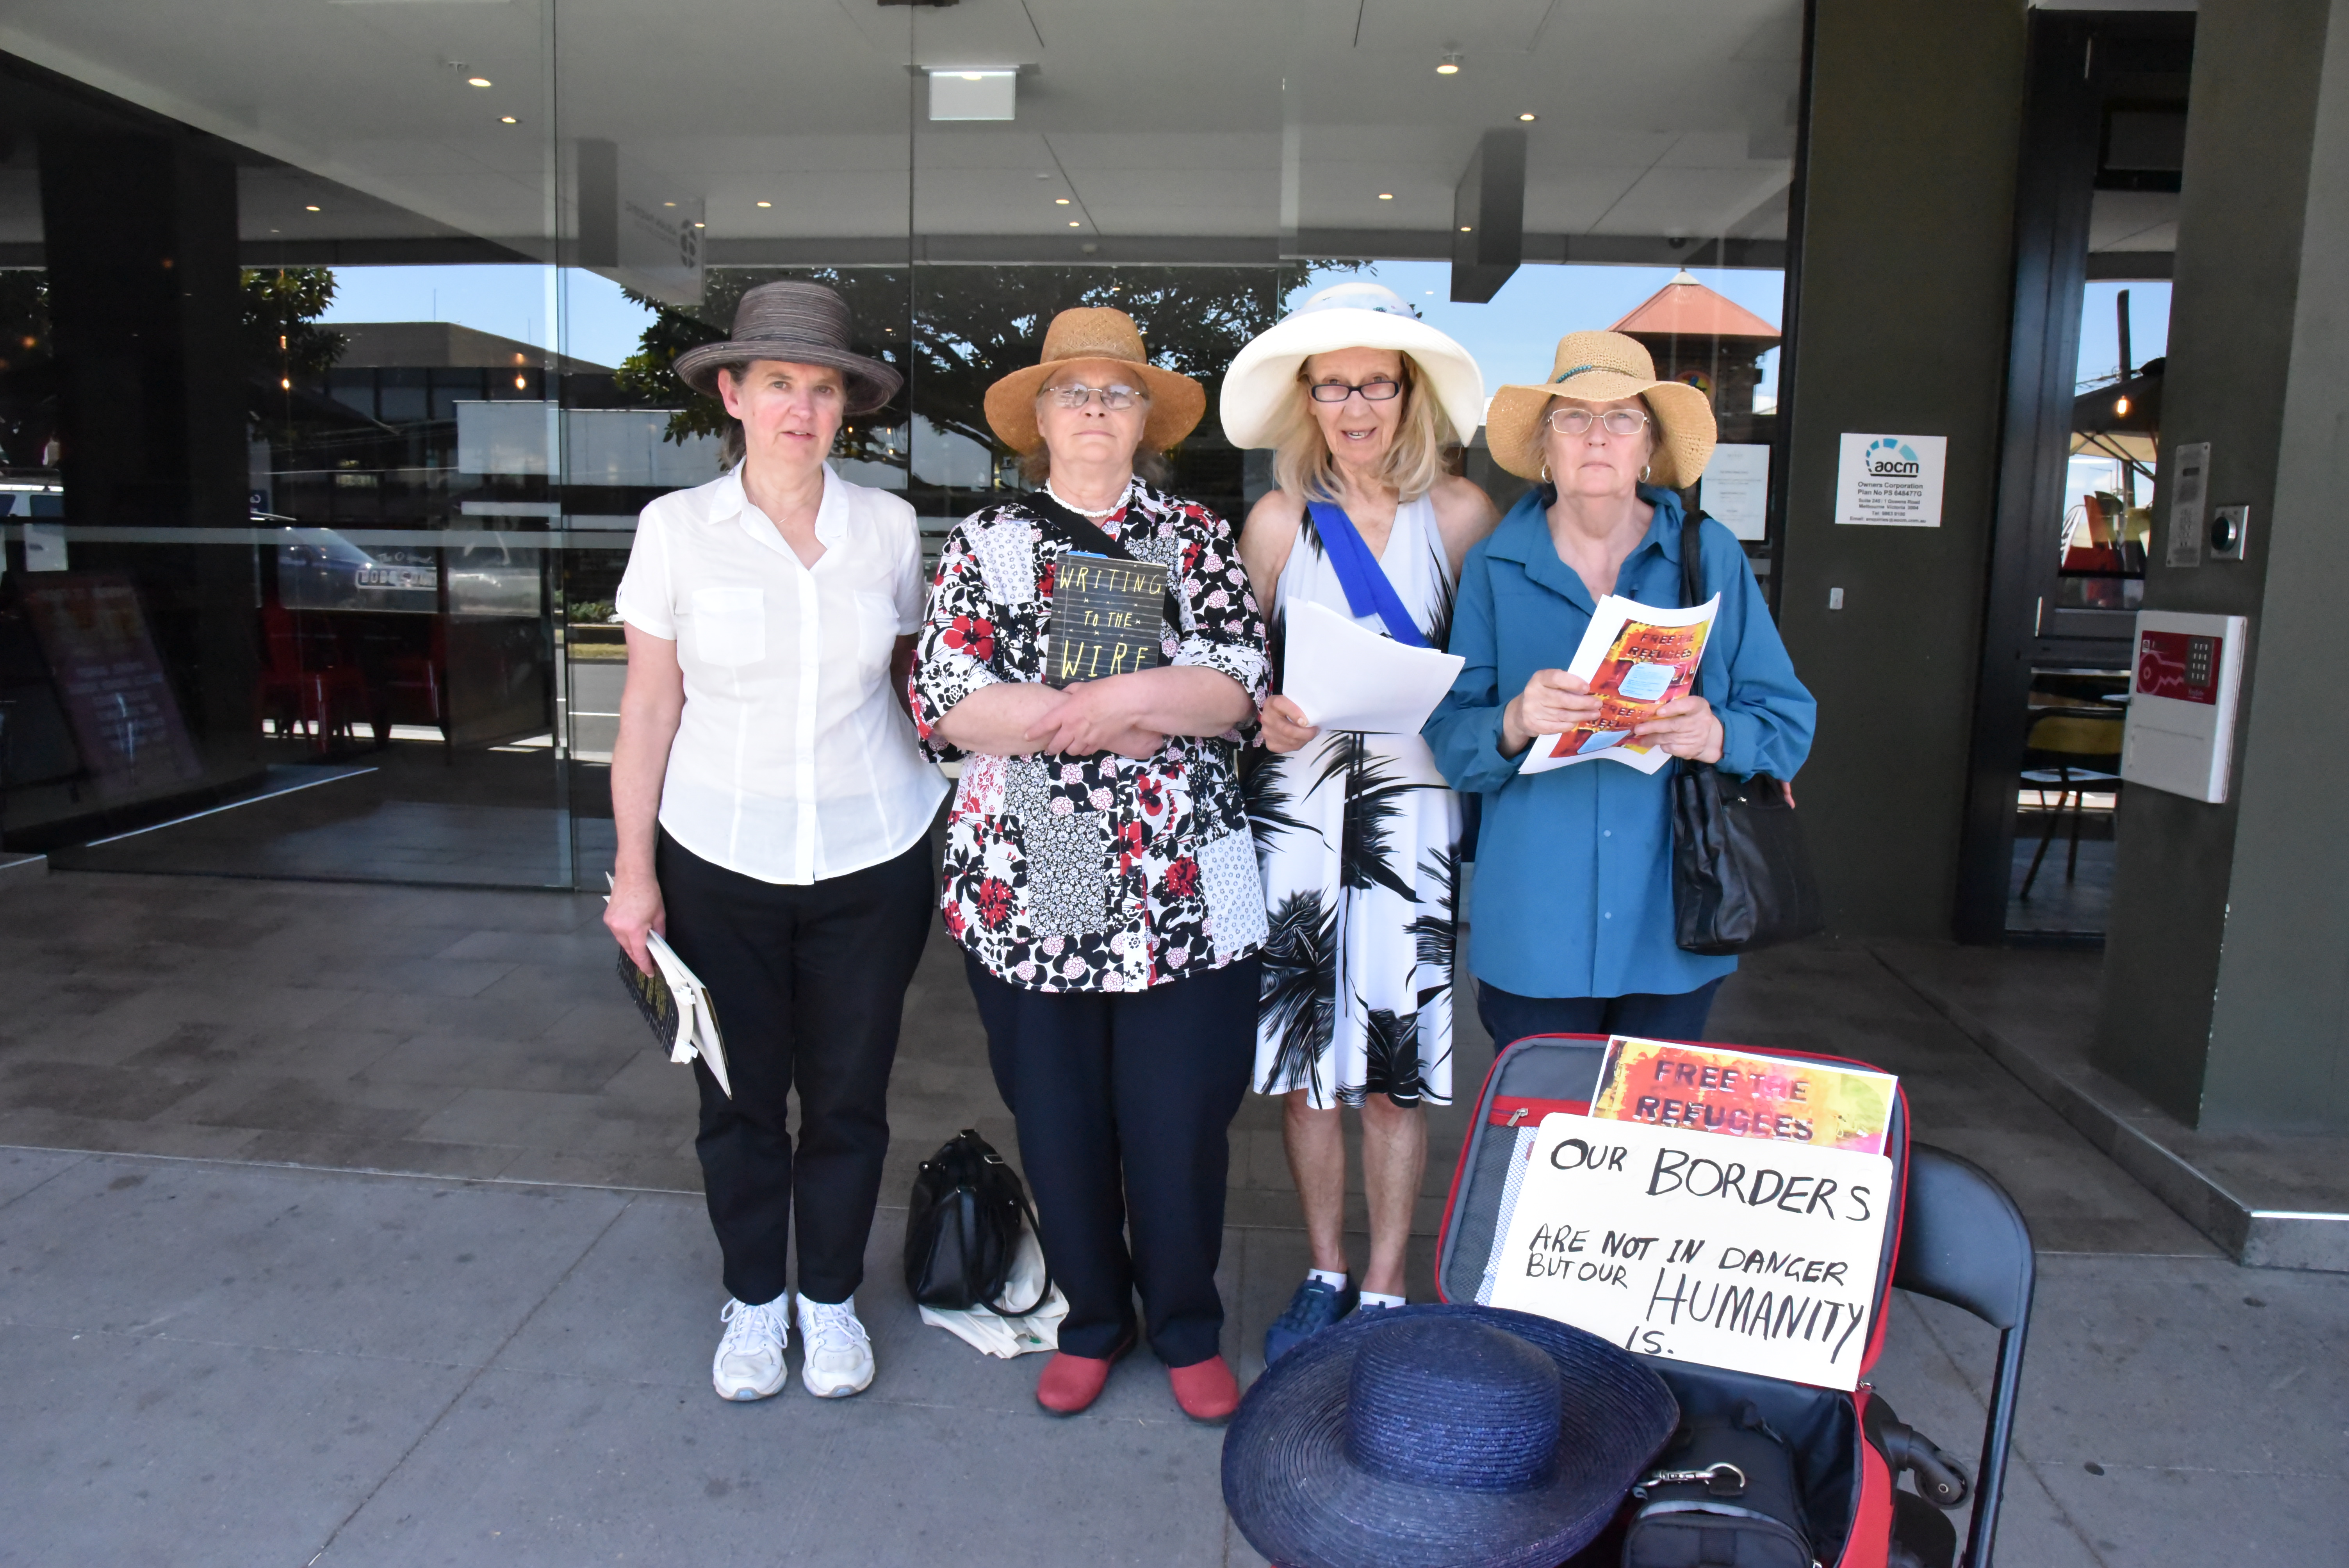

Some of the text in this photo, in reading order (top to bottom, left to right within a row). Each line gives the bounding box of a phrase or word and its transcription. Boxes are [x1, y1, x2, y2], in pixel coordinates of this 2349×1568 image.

[1875, 461, 1919, 473] aocm
[1060, 565, 1161, 594] WRITING
[1085, 611, 1133, 627] TO THE
[1640, 633, 1676, 645] FREE
[1654, 1060, 1811, 1103] FREE THE
[1633, 1095, 1813, 1141] REFUGEES
[1551, 1139, 1870, 1221] OUR BORDERS
[1529, 1223, 1848, 1286] ARE NOT IN DANGER
[1526, 1253, 1864, 1363] BUT OUR HUMANITY
[1625, 1326, 1674, 1354] IS.
